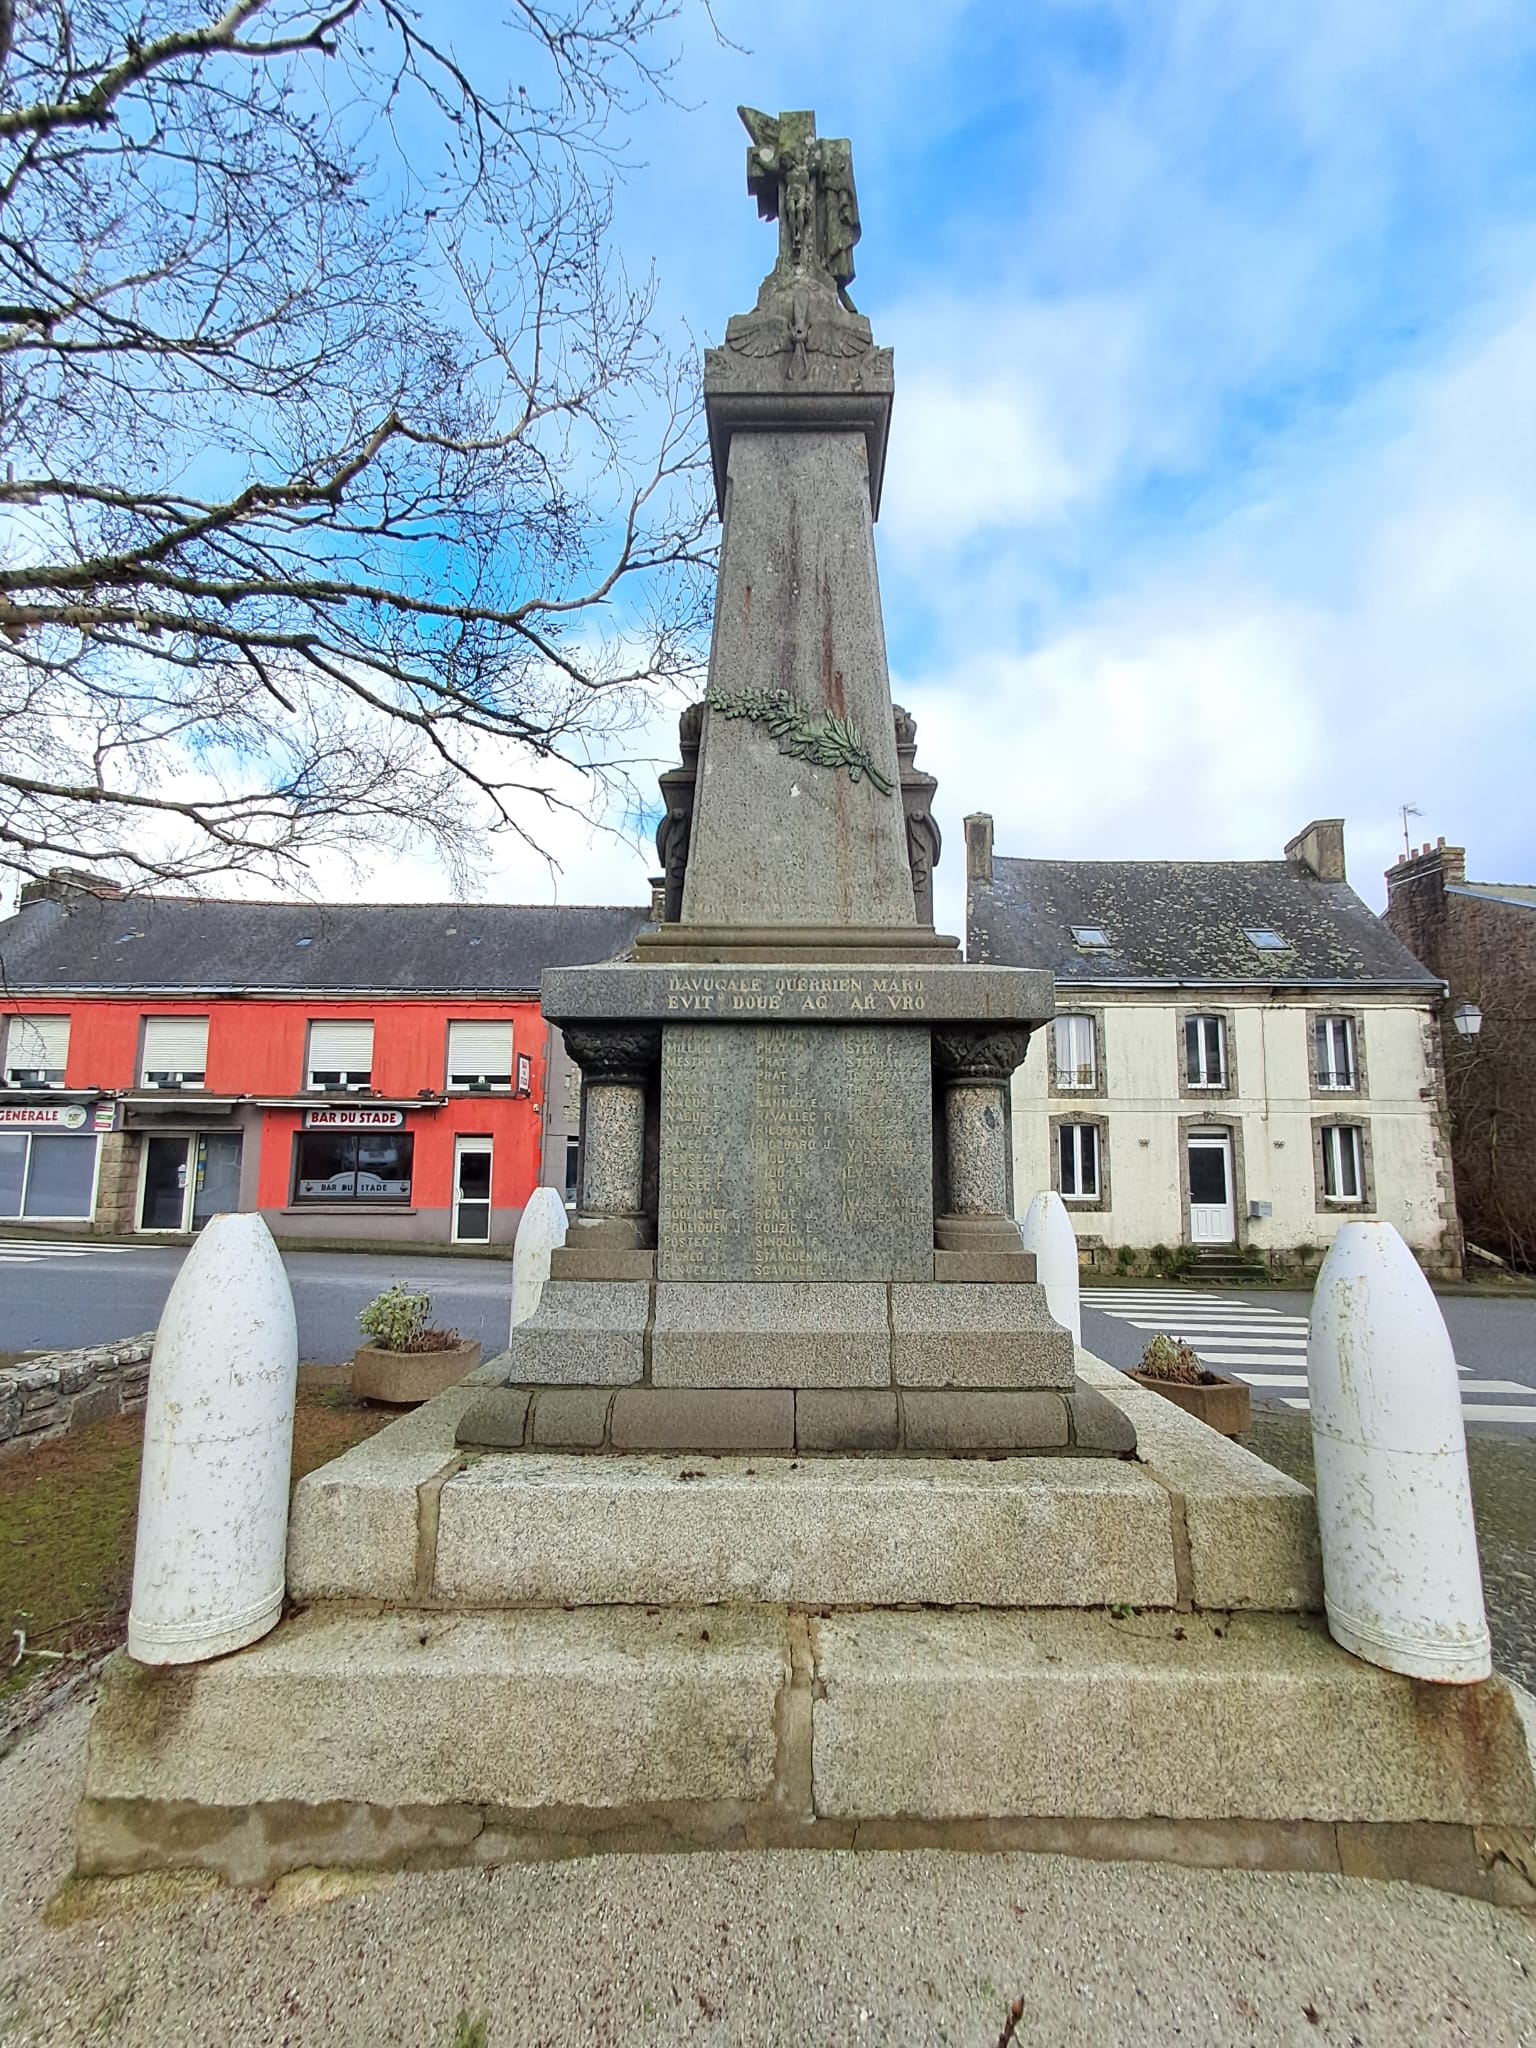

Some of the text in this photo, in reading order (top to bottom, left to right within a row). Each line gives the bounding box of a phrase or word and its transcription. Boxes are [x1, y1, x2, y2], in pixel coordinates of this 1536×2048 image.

[775, 977, 862, 995] QUERRIEN
[873, 977, 922, 992] MARO
[667, 994, 713, 1009] EVIT
[732, 994, 781, 1009] DOUE
[849, 994, 876, 1009] AR
[887, 994, 924, 1009] VRO
[757, 1070, 788, 1081] PRAT
[311, 1111, 397, 1124] BAR DU STADE
[757, 1110, 816, 1122] RIVALLEC
[664, 1208, 726, 1220] POULICHET
[755, 1222, 797, 1234] ROUZIC
[664, 1236, 708, 1247] POSTEC
